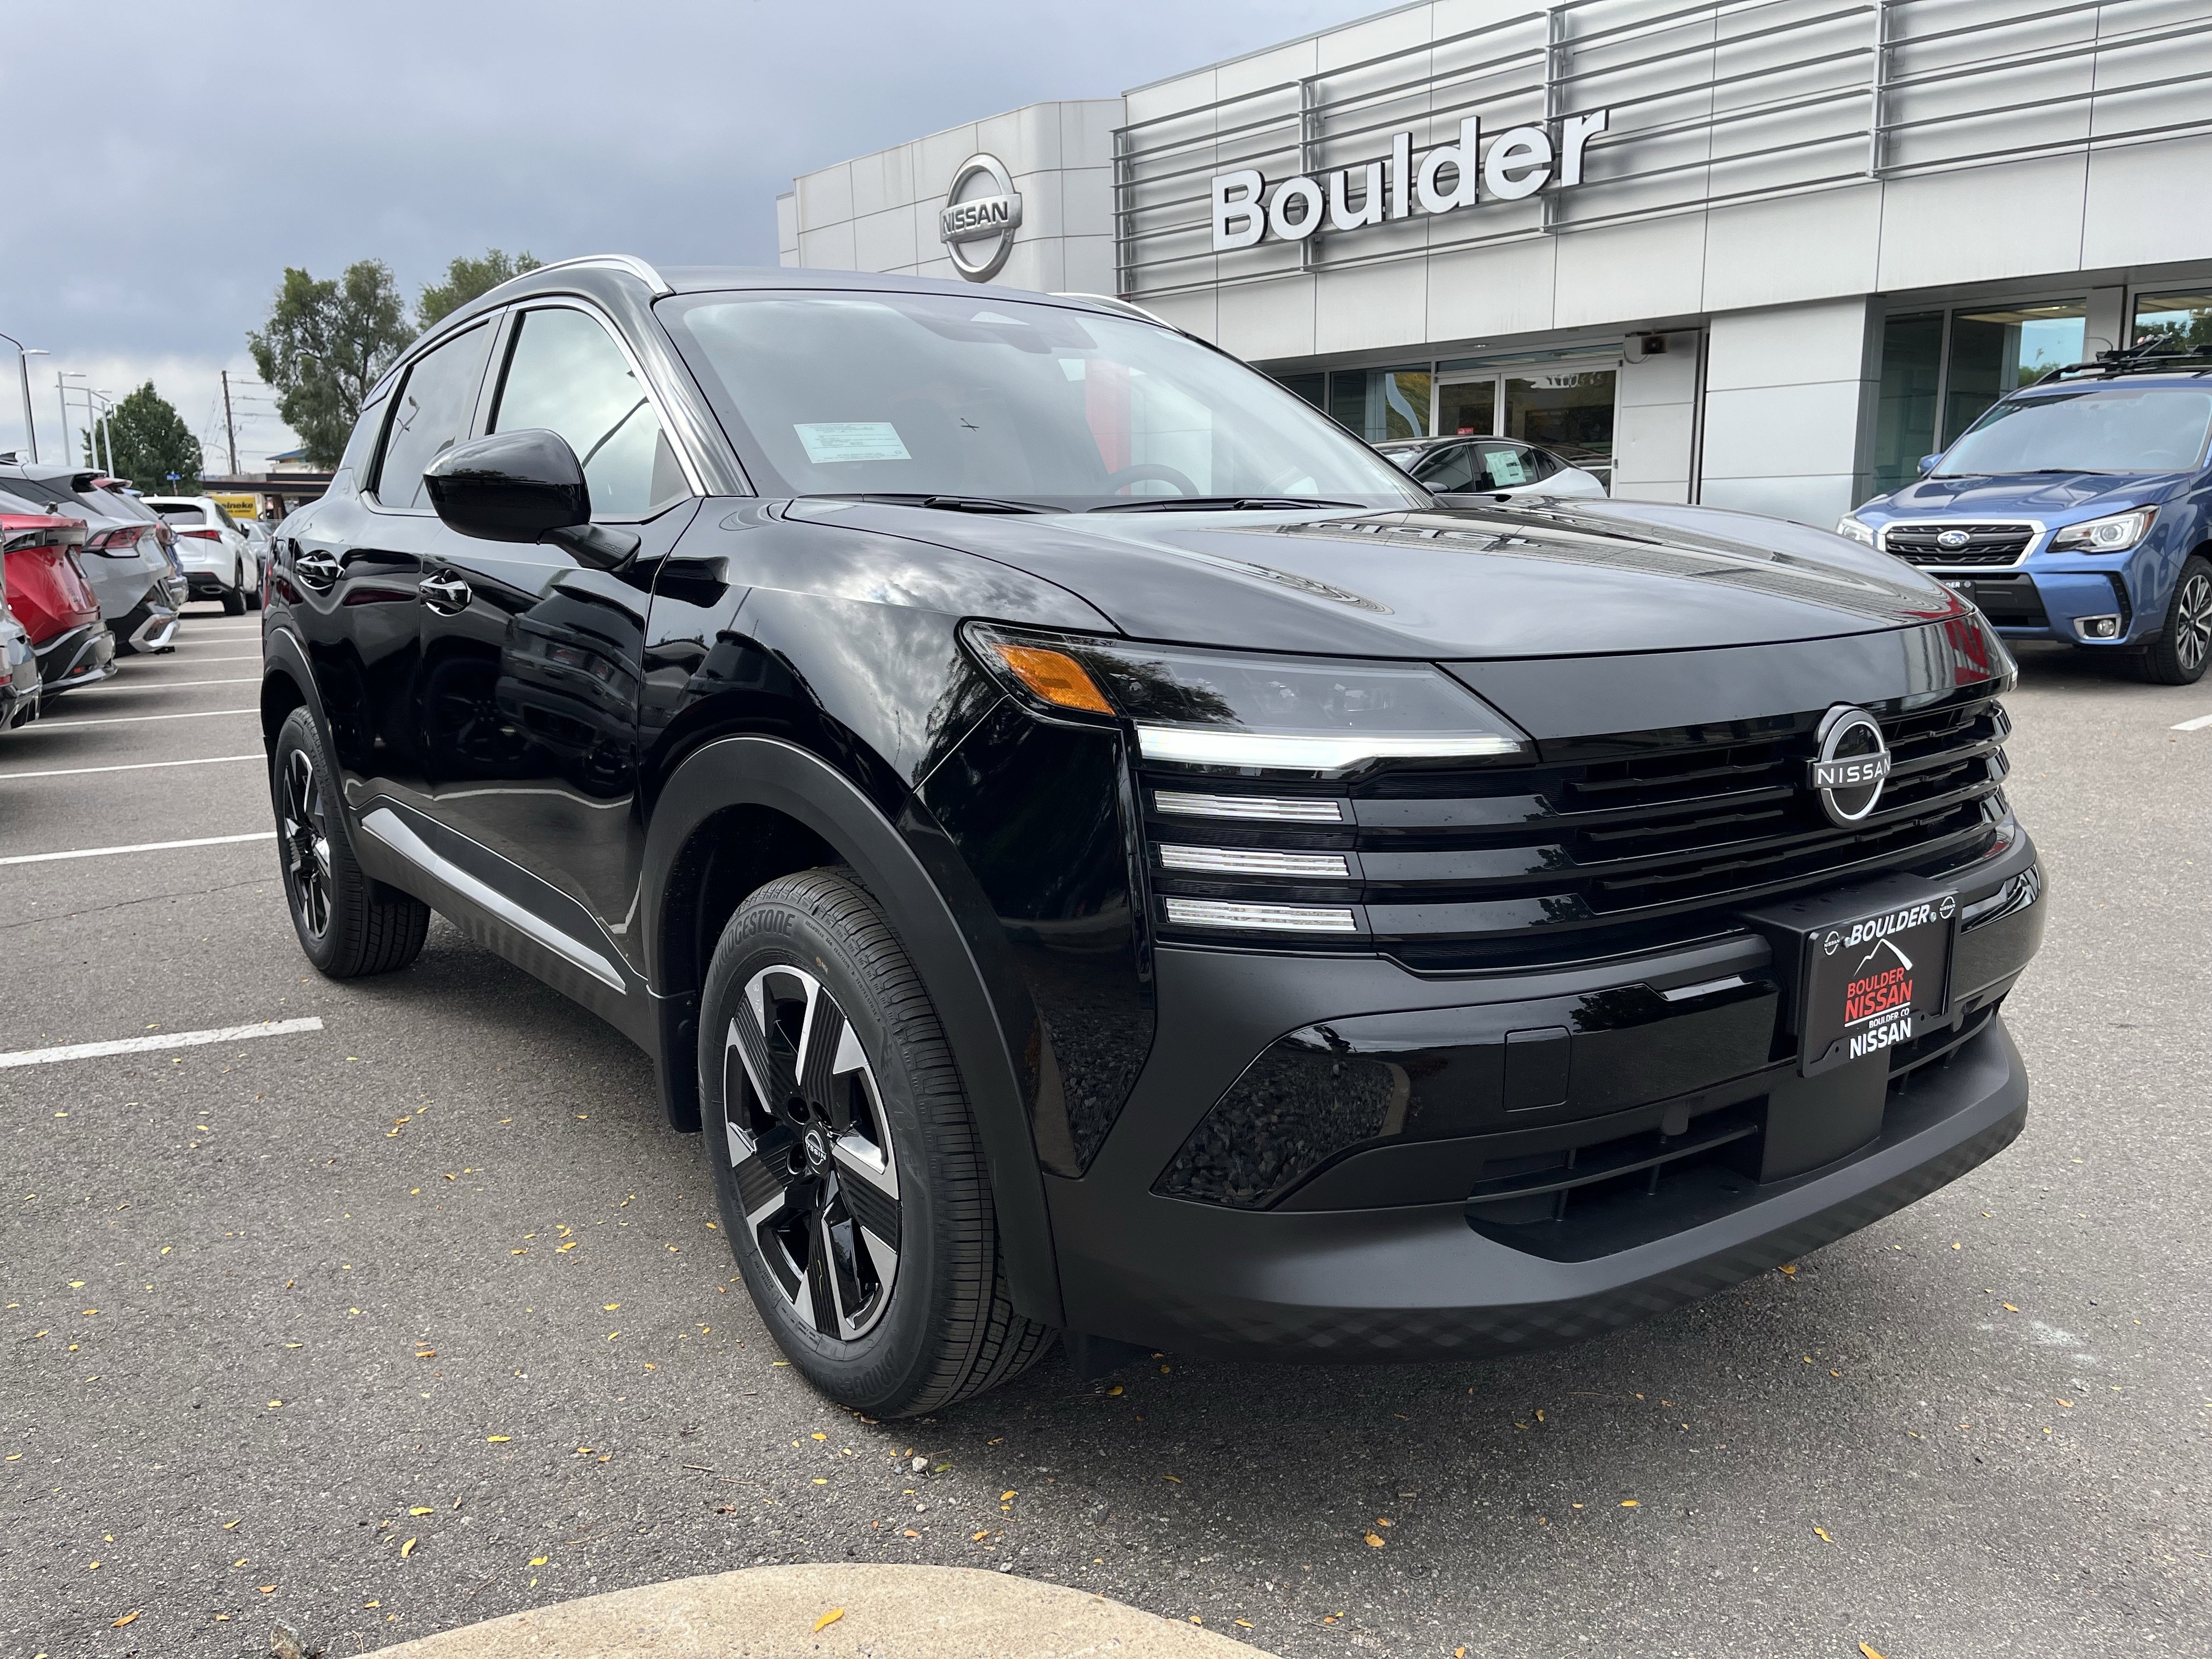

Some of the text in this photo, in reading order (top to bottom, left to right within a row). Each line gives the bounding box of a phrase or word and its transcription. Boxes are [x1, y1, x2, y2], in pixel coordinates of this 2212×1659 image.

[1211, 109, 1609, 251] Boulder
[943, 201, 1008, 235] NISSAN
[1817, 755, 1891, 785] NISSAN
[713, 909, 795, 977] BRIDGESTONE
[1850, 904, 1930, 946] BOULDER
[1844, 979, 1912, 1022] NISSAN
[1847, 967, 1905, 998] BOULDER
[1849, 1017, 1911, 1059] NISSAN
